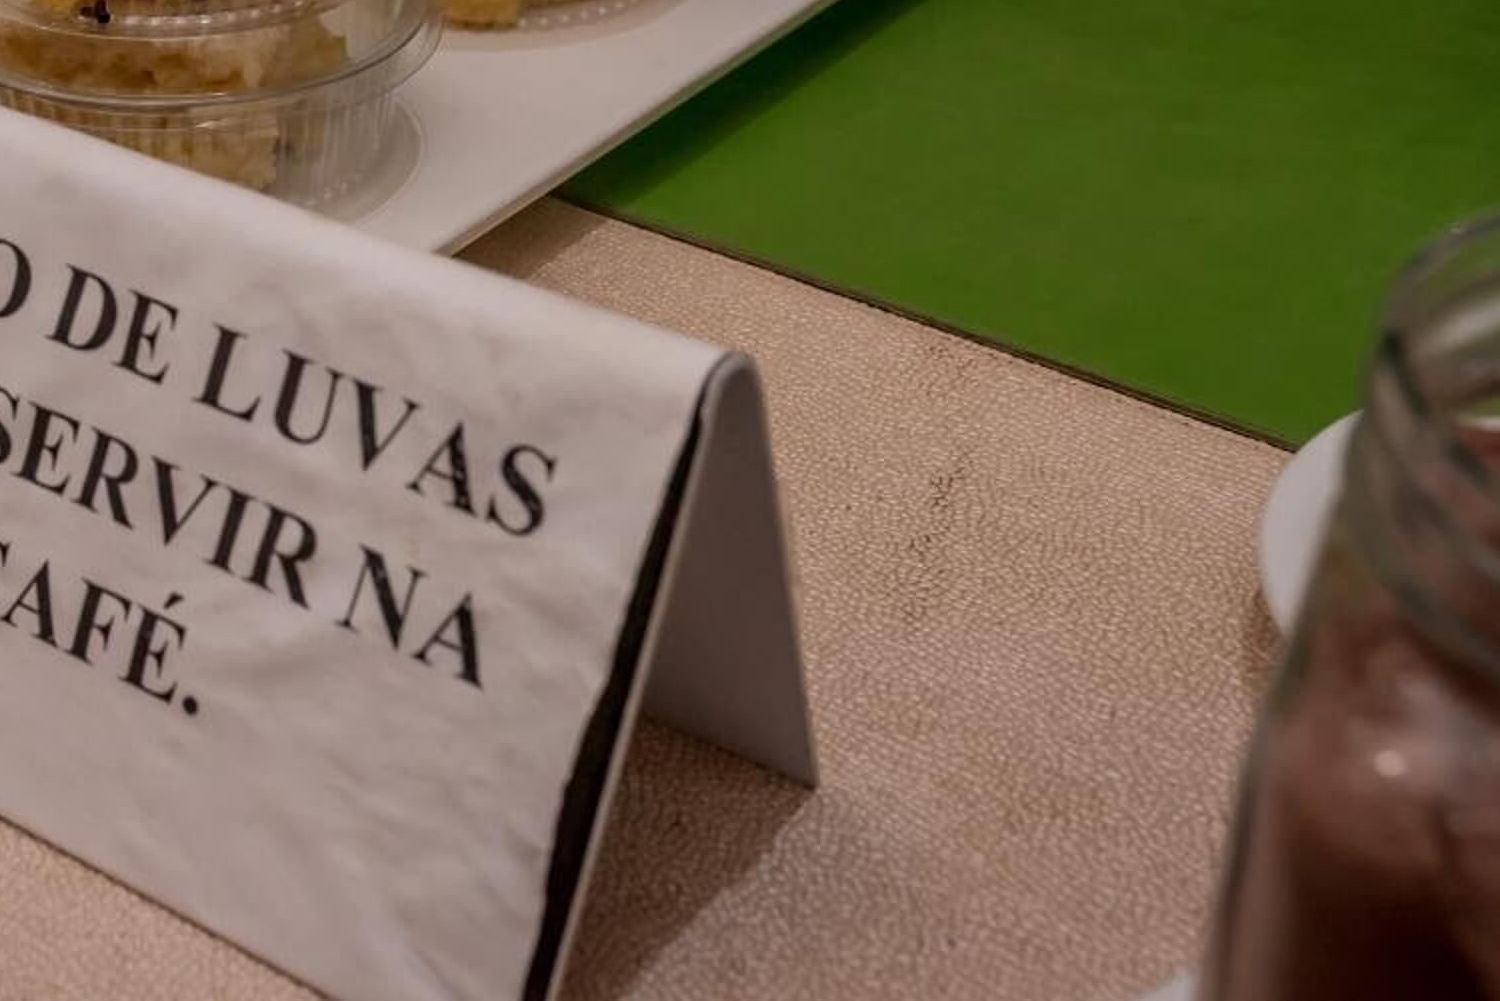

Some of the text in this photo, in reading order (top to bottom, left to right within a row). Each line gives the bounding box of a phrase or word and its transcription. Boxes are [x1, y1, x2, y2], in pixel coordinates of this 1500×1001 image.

[47, 265, 179, 385] DE
[192, 324, 557, 537] LUVAS
[338, 545, 483, 691] NA
